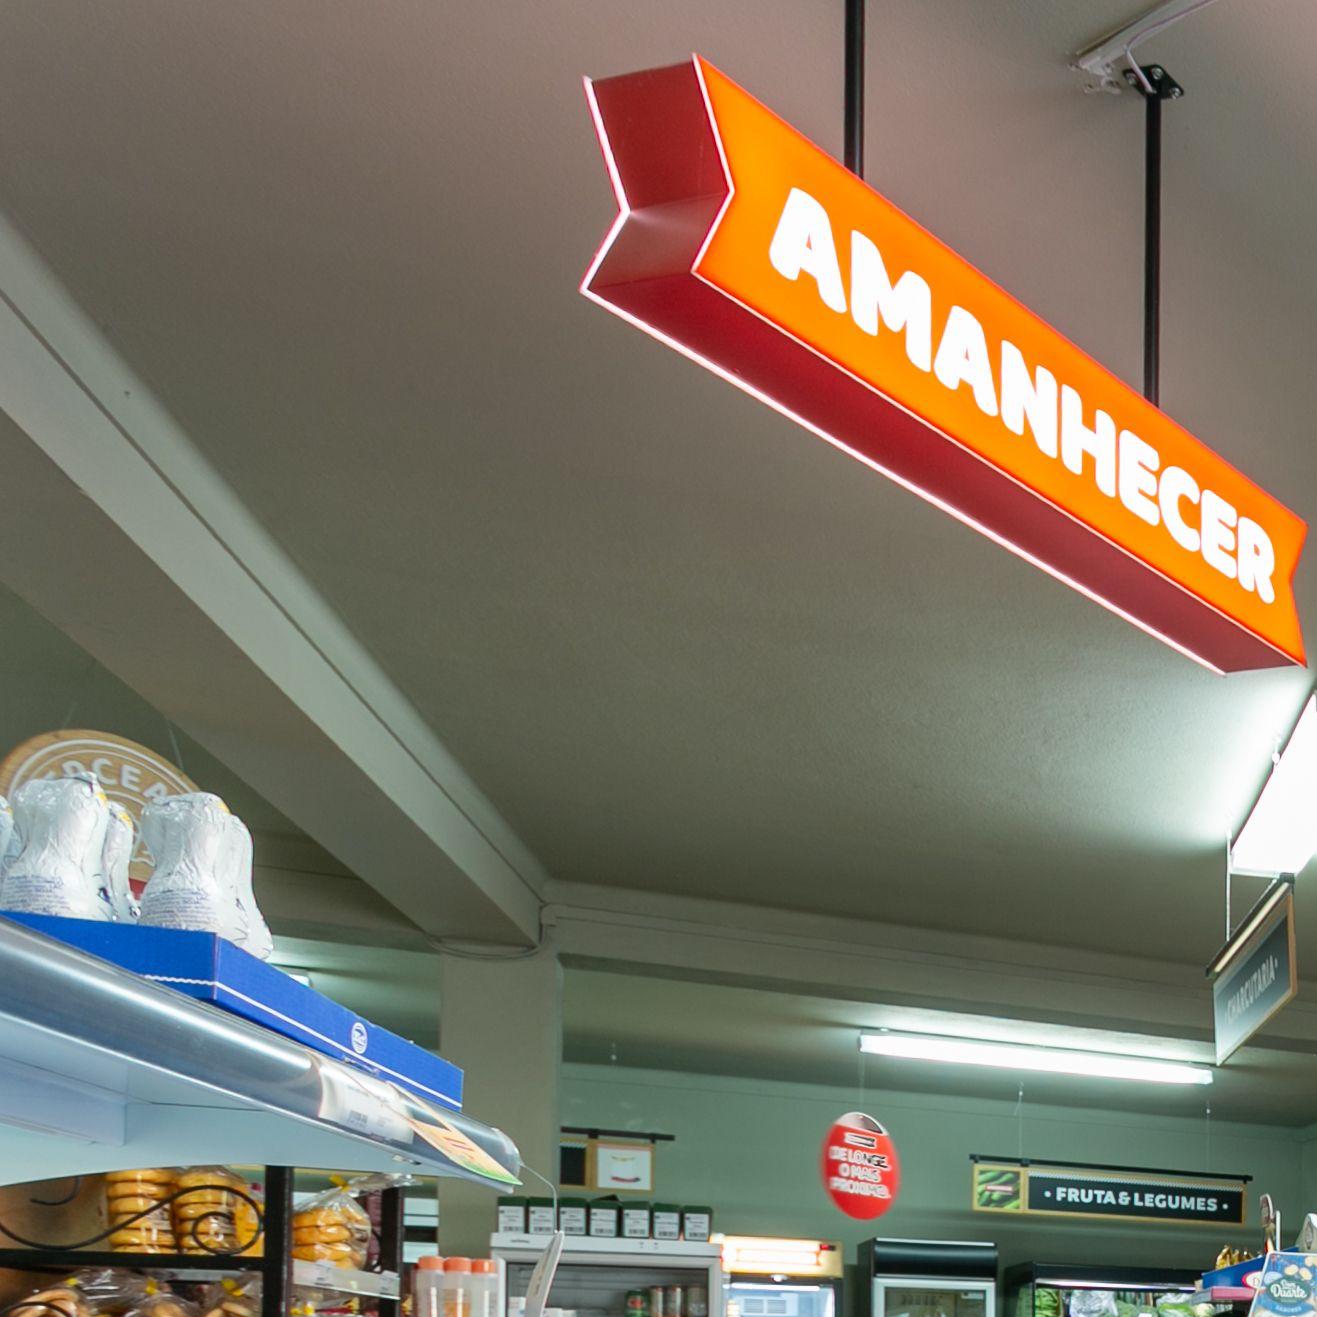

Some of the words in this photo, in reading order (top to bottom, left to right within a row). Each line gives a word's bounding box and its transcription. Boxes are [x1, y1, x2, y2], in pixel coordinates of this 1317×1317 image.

[769, 187, 1275, 604] AMANHECER
[1227, 954, 1276, 1025] CHARCUTARIA
[1056, 1186, 1116, 1205] FRUTA
[1133, 1191, 1218, 1212] LEGUMES
